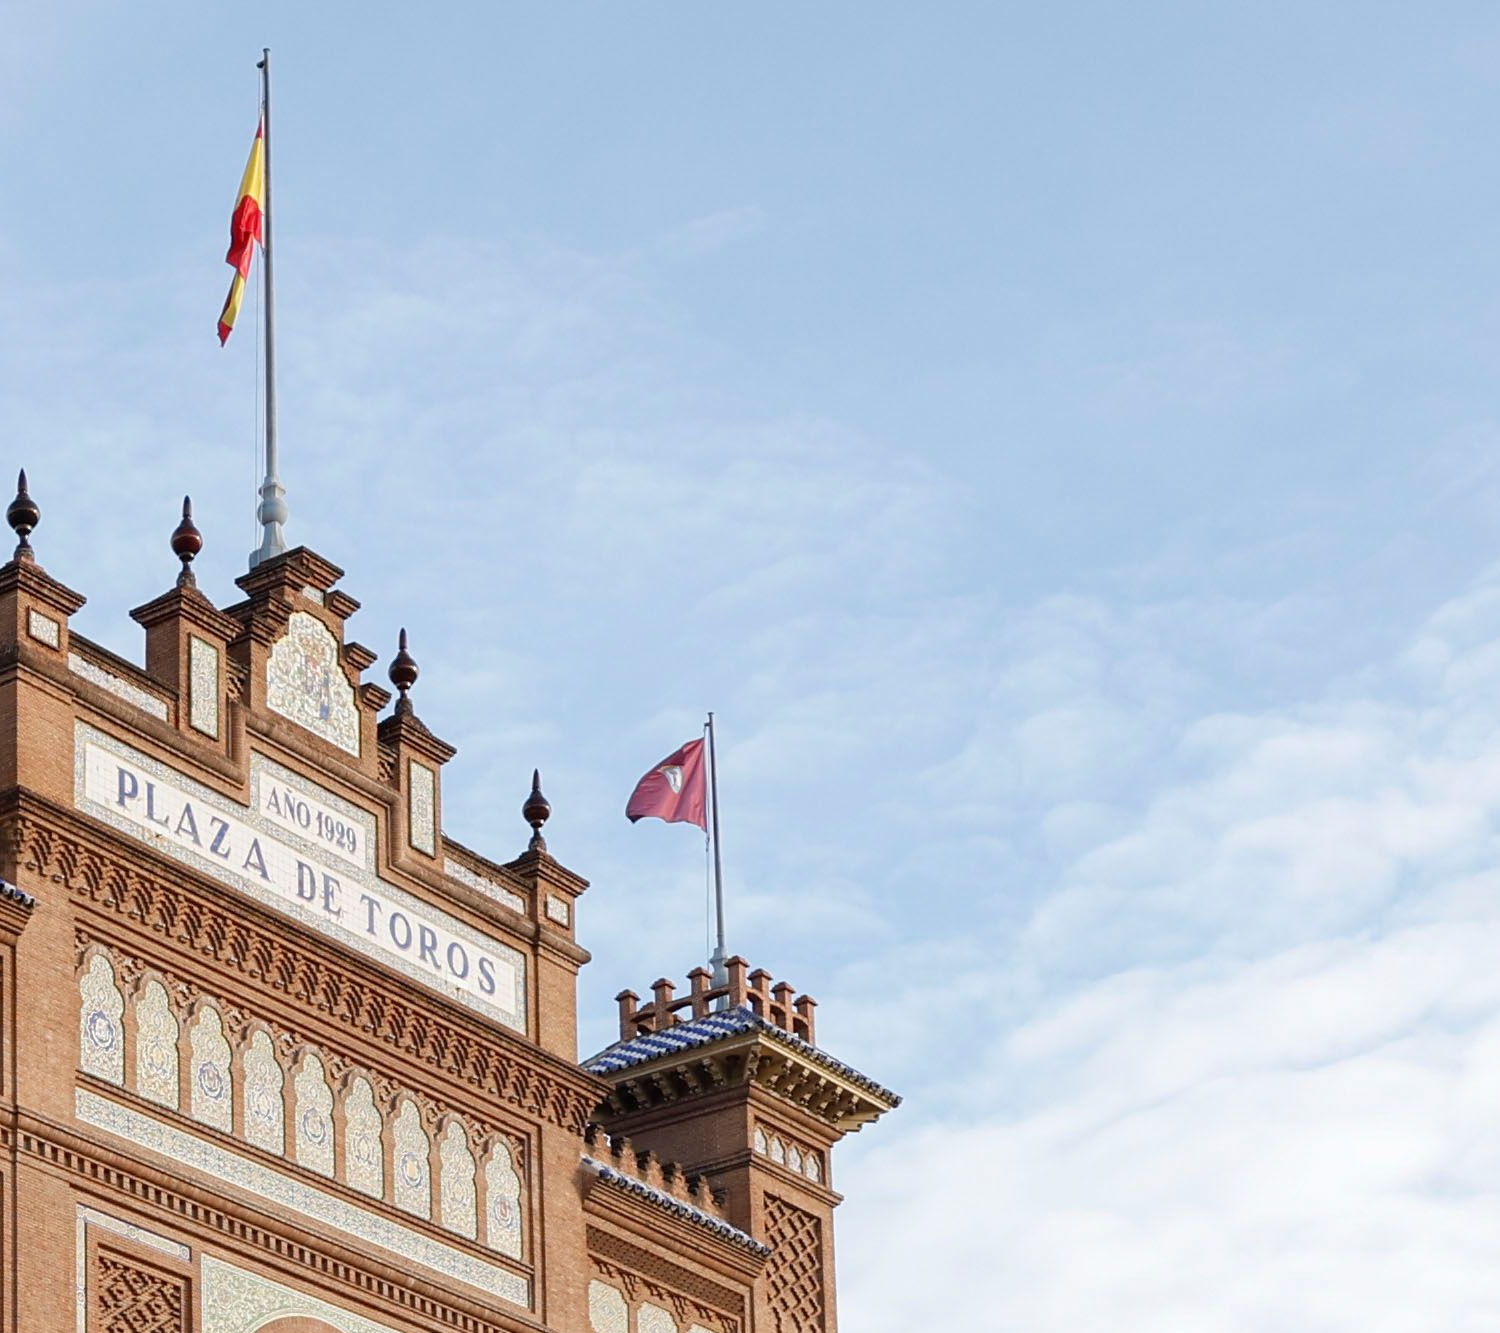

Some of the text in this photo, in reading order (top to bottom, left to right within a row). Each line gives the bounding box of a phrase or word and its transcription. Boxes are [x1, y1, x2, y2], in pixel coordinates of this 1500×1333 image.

[116, 765, 498, 995] PLAZA DE TOROS
[266, 783, 358, 856] AÑO 1929
